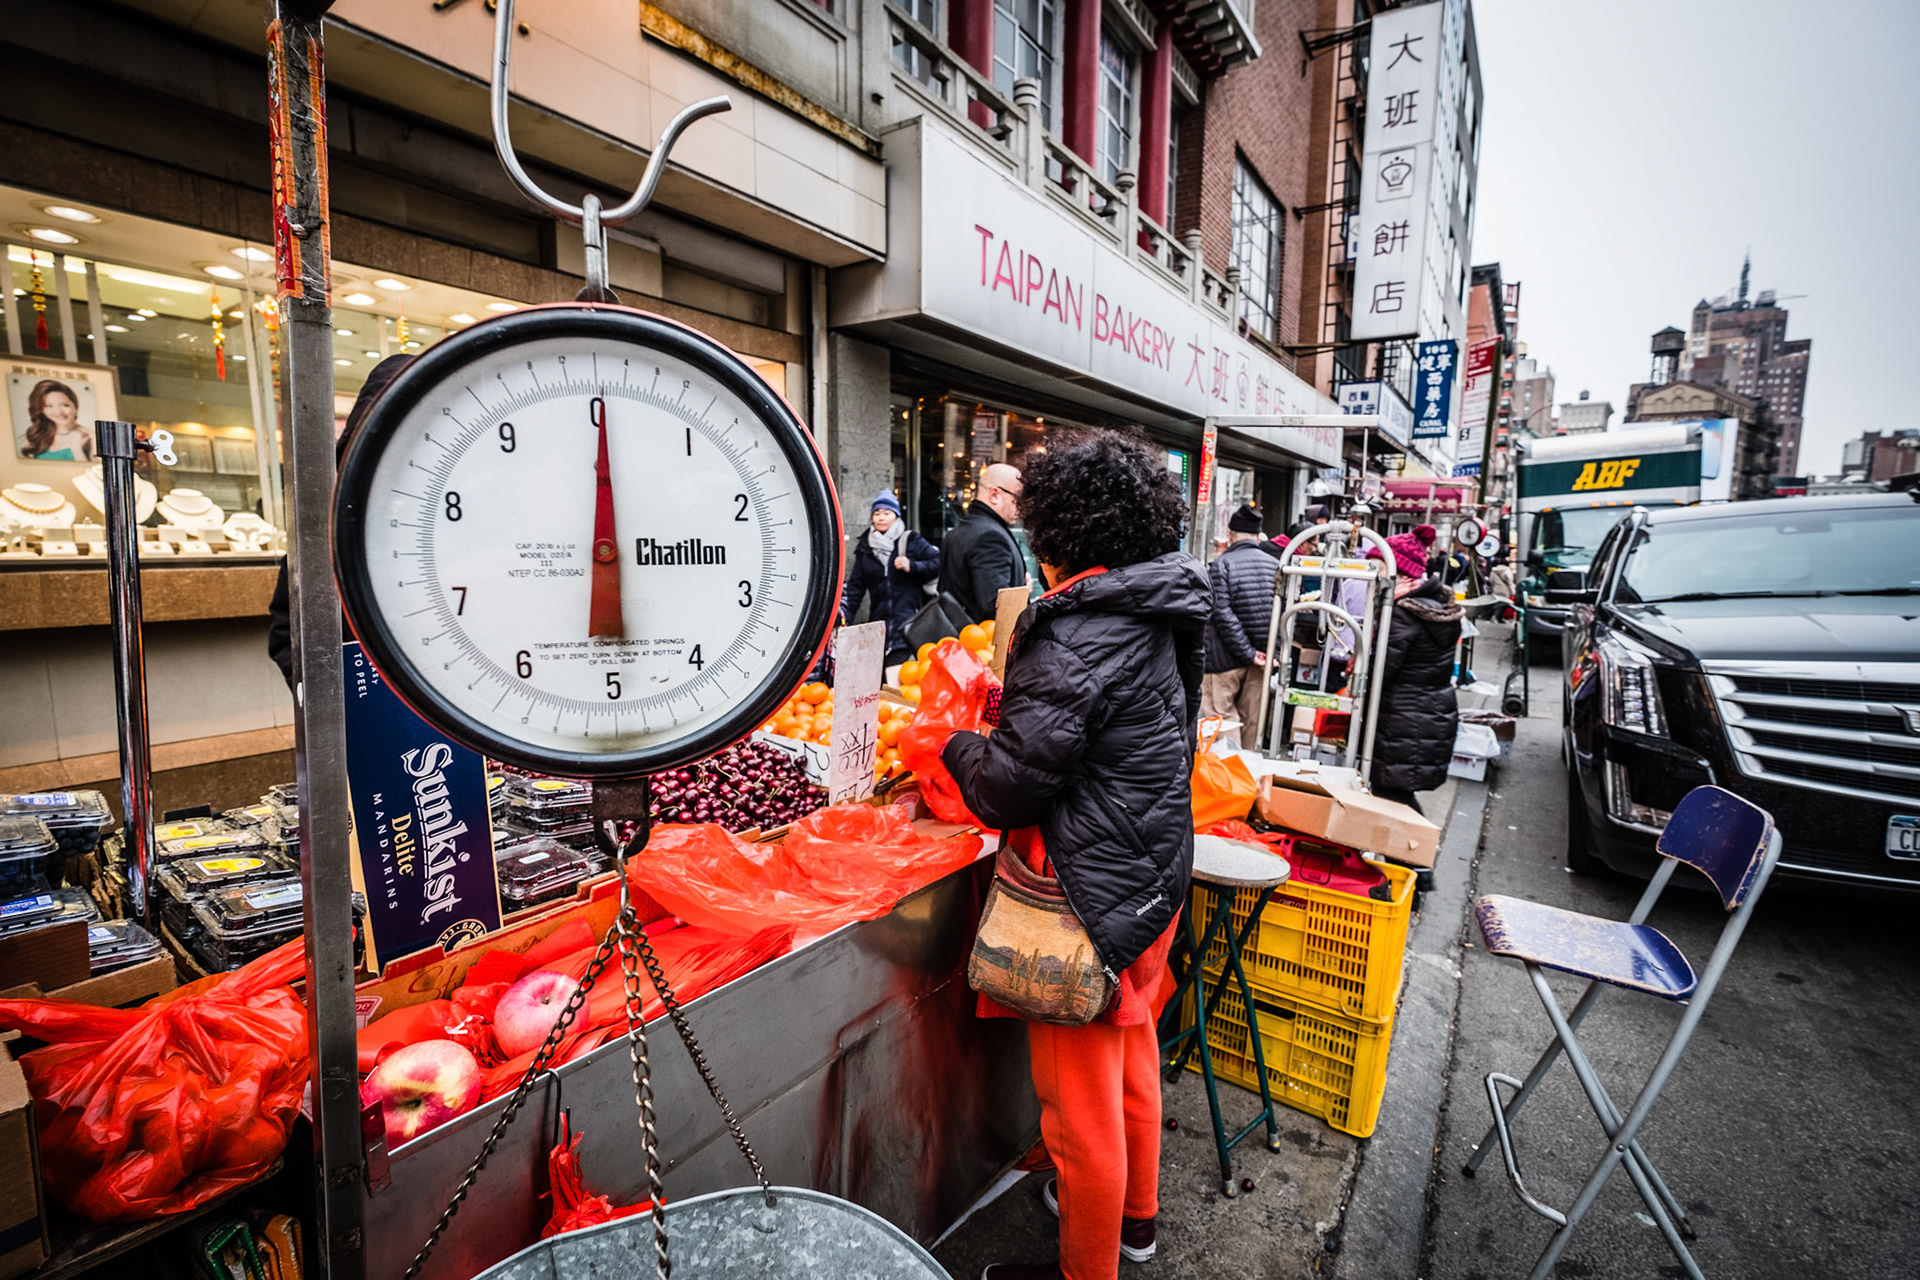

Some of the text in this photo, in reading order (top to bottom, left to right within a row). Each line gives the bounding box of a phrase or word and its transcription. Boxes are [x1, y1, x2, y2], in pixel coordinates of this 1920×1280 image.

[1370, 33, 1424, 315] 大班 餅店
[974, 224, 1083, 331] TAIPAN
[1094, 294, 1175, 372] BAKERY
[499, 422, 516, 453] 9
[1572, 459, 1641, 491] ABF
[445, 491, 462, 521] 8
[734, 494, 749, 521] 2
[636, 538, 726, 566] Chatillon
[508, 570, 531, 578] NTEP
[533, 569, 546, 578] CC
[451, 587, 467, 615] 7
[738, 580, 753, 608] 3
[534, 642, 588, 650] TEMPERATURE
[594, 639, 650, 648] COMPENSATED
[688, 644, 704, 671] 4
[353, 652, 368, 698] TO PEEL
[516, 650, 533, 679] 6
[606, 672, 622, 700] 5
[400, 742, 470, 922] Sunkist
[372, 793, 399, 910] MANDARINS
